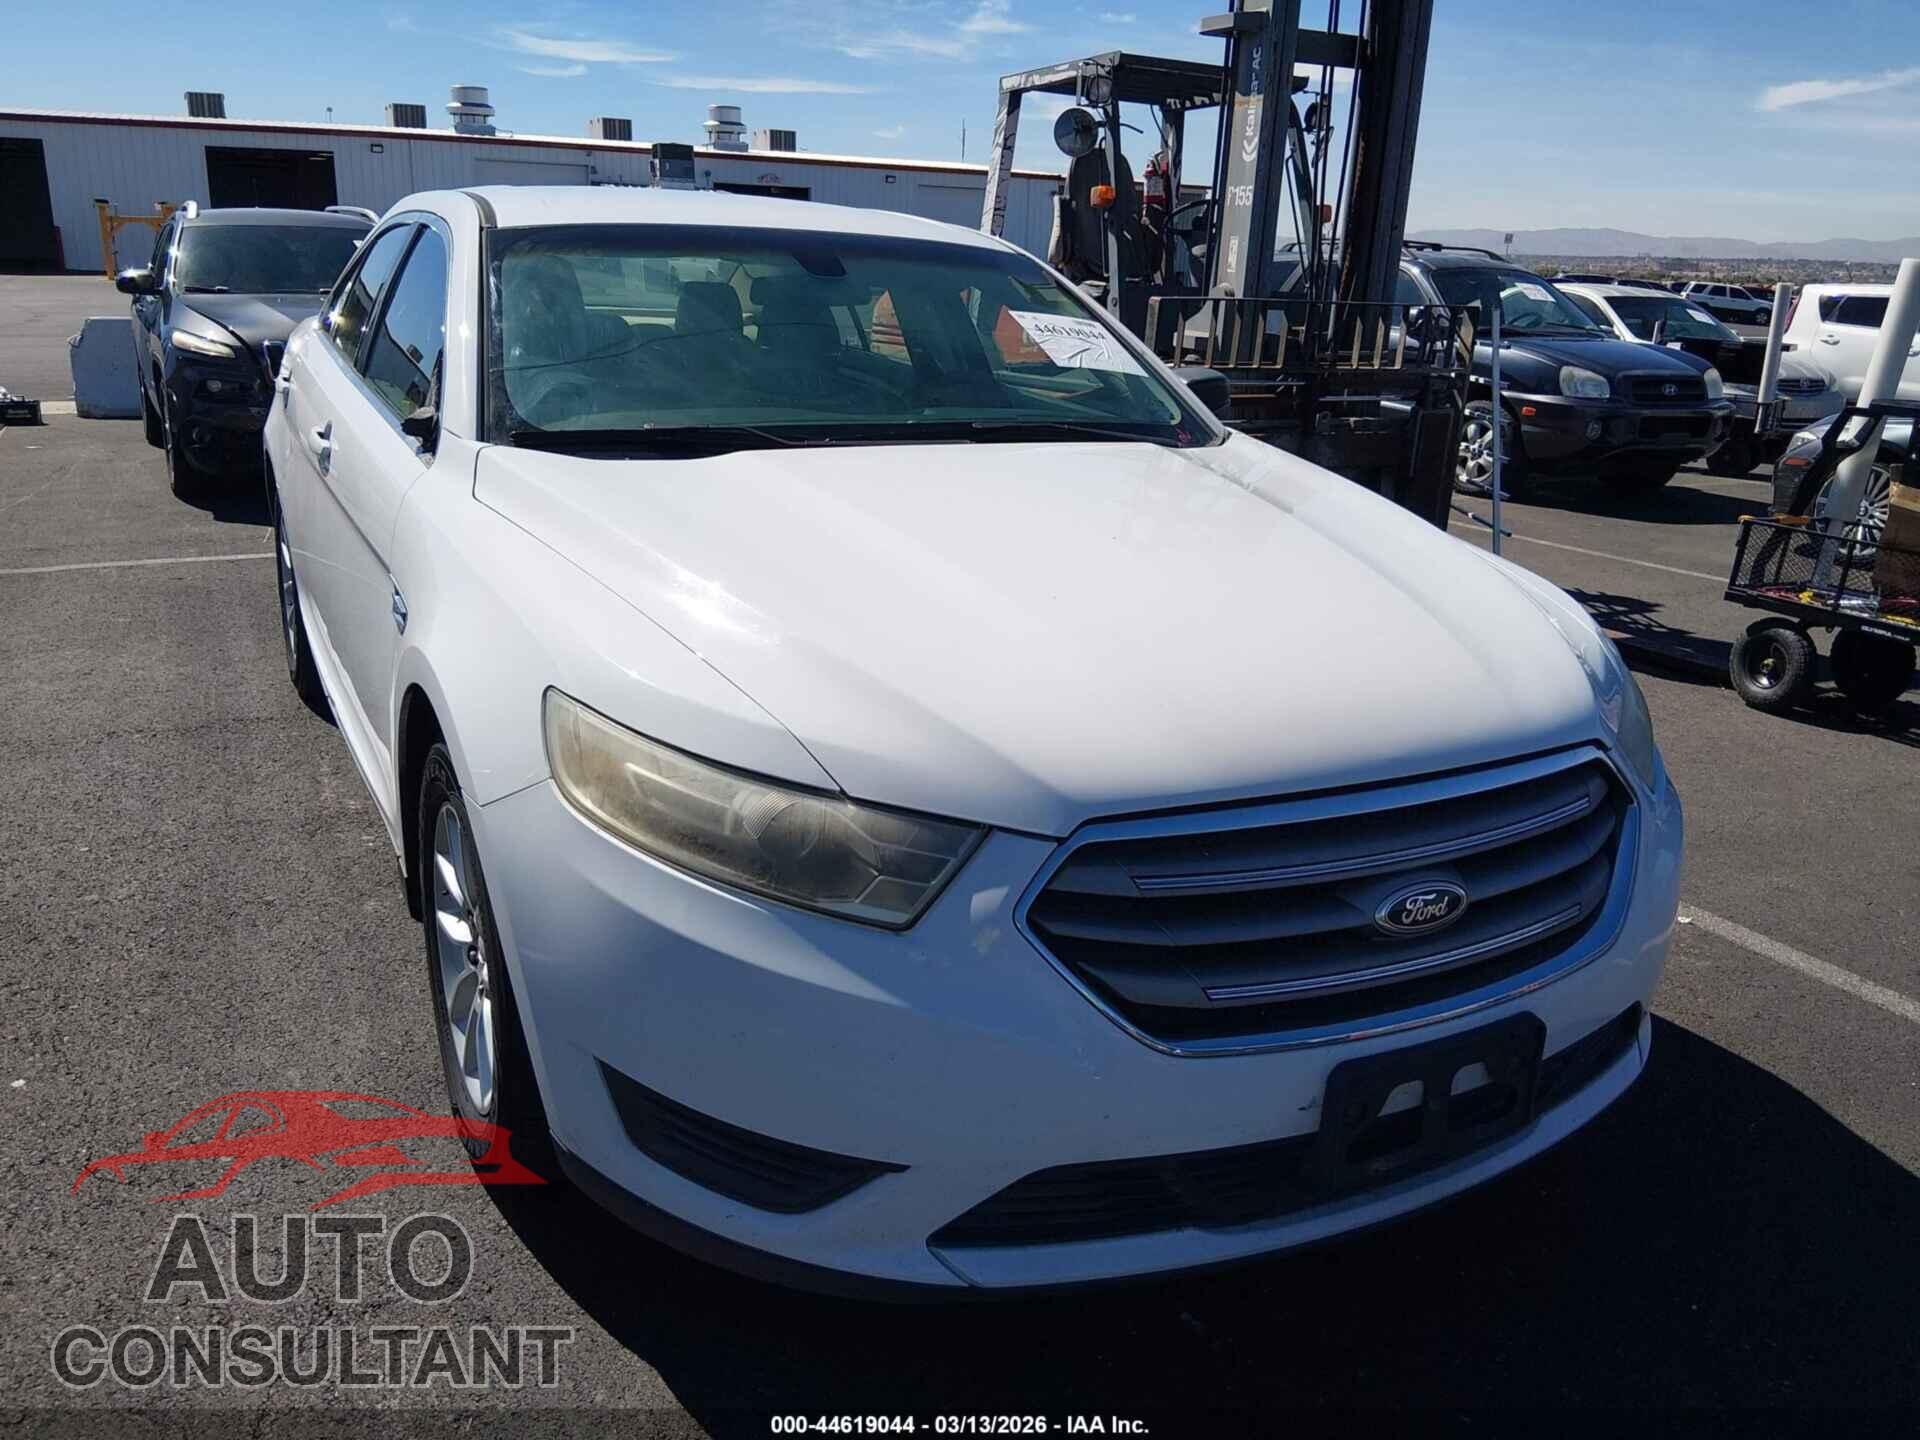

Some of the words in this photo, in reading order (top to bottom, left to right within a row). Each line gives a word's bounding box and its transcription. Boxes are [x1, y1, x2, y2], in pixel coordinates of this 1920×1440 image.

[1252, 46, 1262, 70] AC
[1034, 322, 1105, 340] 44619044
[1402, 893, 1449, 924] Ford
